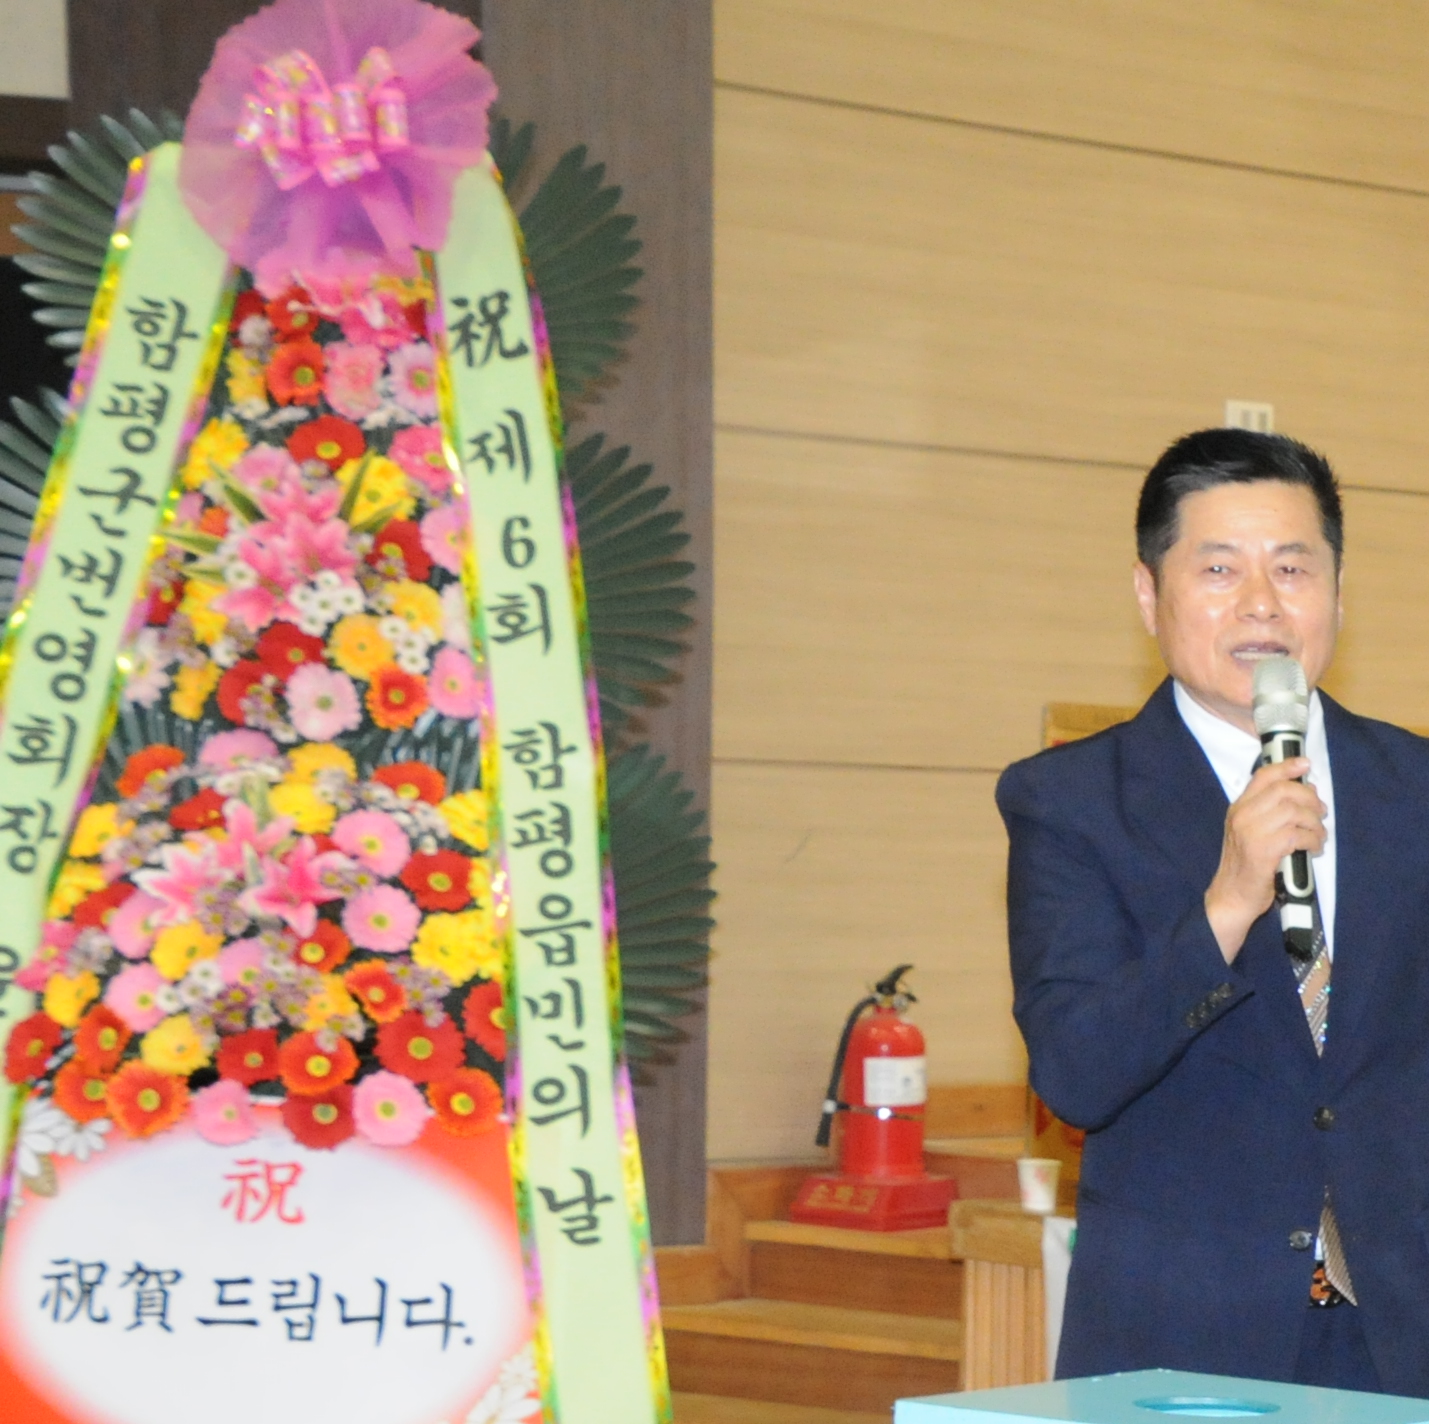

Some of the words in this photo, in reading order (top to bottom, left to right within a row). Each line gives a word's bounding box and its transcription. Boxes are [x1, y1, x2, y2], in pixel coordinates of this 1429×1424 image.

[448, 291, 528, 368] 祝
[537, 1168, 615, 1246] 날
[222, 1158, 306, 1226] 祝
